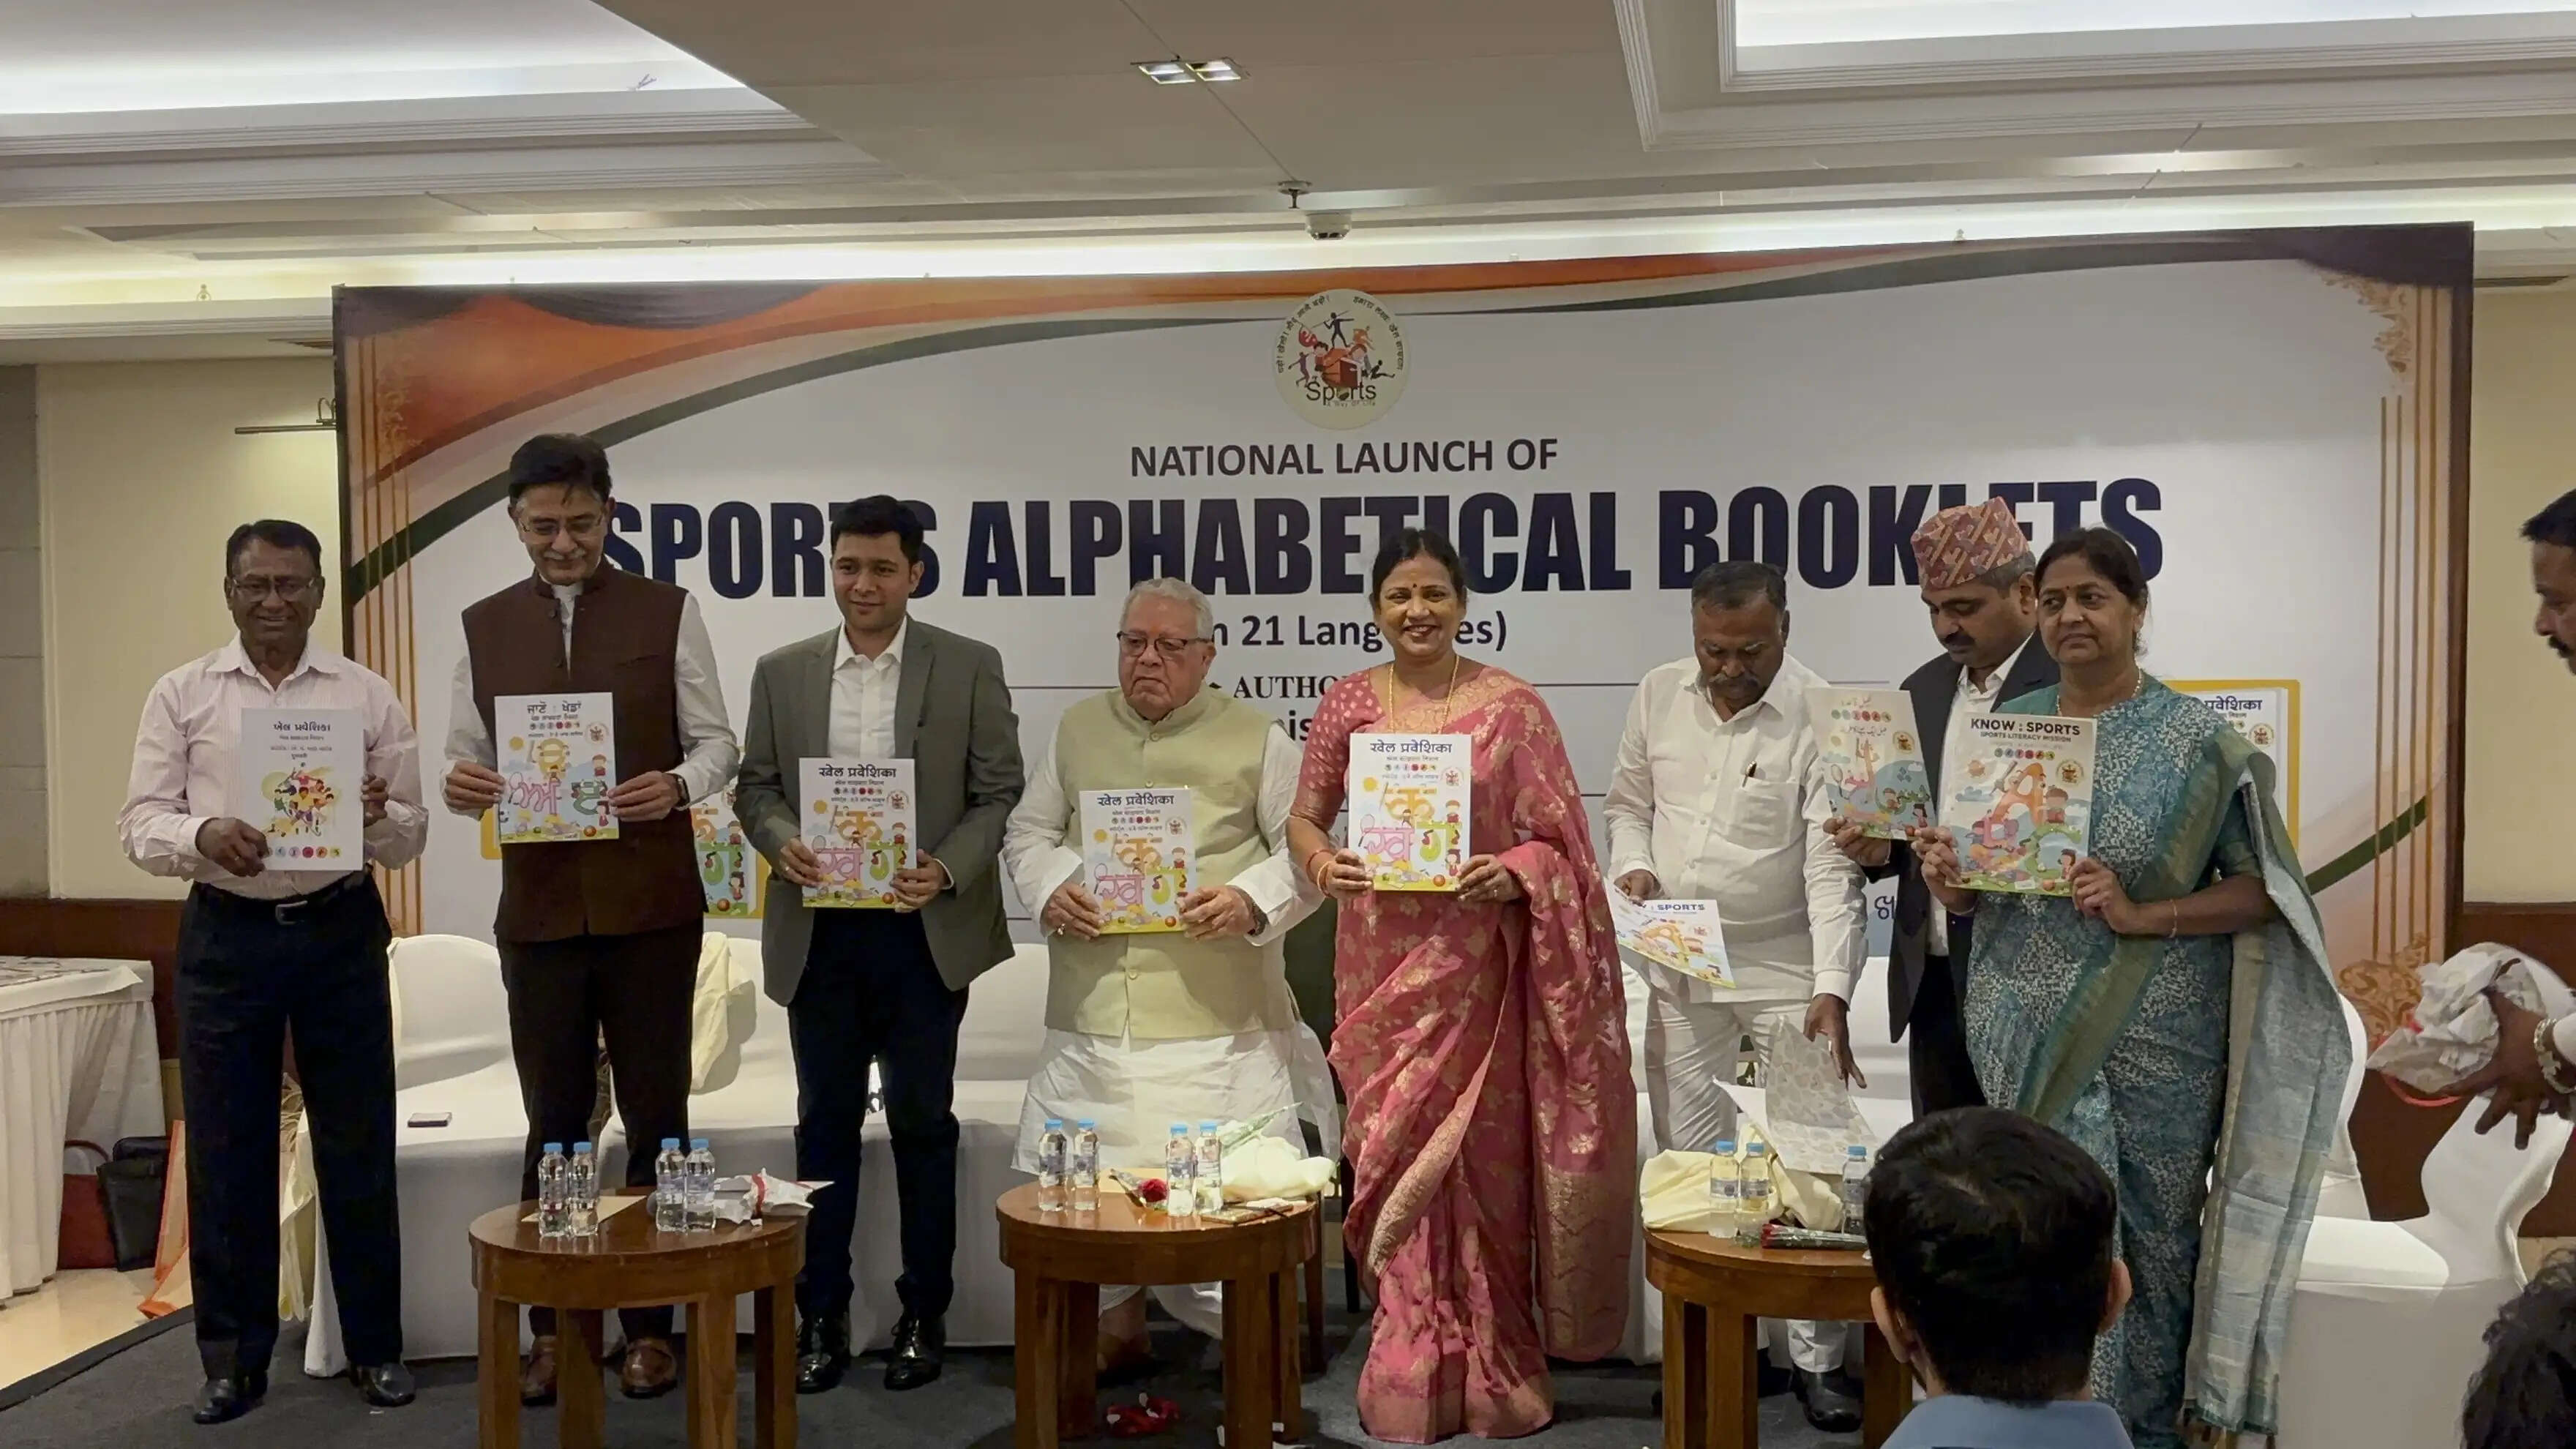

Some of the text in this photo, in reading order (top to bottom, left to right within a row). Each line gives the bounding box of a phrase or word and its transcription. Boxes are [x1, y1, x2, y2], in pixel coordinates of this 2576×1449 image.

[1131, 438, 1557, 476] NATIONAL LAUNCH OF
[1241, 615, 1284, 646] 21
[1298, 610, 1507, 653] Langes)
[1971, 718, 2015, 731] KNOW
[2026, 722, 2081, 735] SPORTS
[2007, 733, 2041, 741] LITERACY
[2043, 735, 2072, 743] MISSION
[1370, 739, 1452, 753] खेल प्रवेशिका
[818, 763, 896, 777] खेल प्रवेशिका
[1097, 793, 1175, 806] खेल प्रवेशिका
